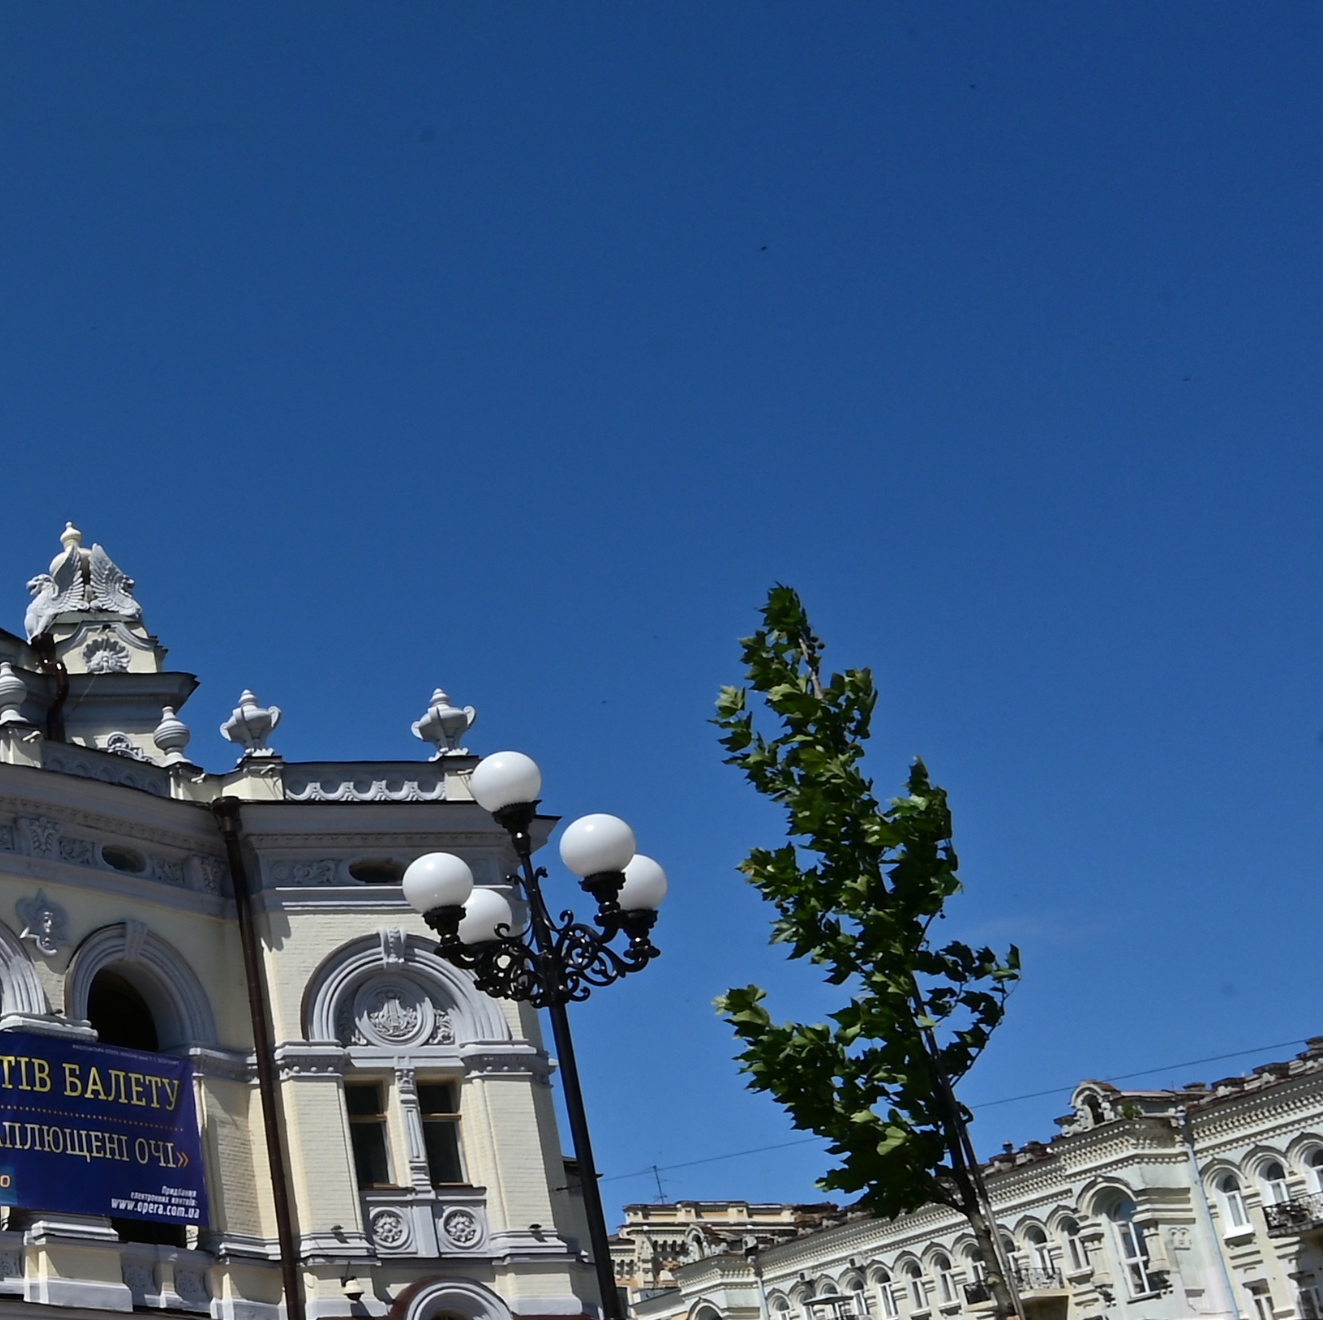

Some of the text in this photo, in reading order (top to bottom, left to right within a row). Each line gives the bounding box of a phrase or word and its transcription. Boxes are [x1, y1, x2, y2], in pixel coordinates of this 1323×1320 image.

[62, 1063, 179, 1111] БАЛЕТУ
[135, 1137, 190, 1168] ОЧІ»
[111, 1198, 200, 1219] www.opera.com.ua
